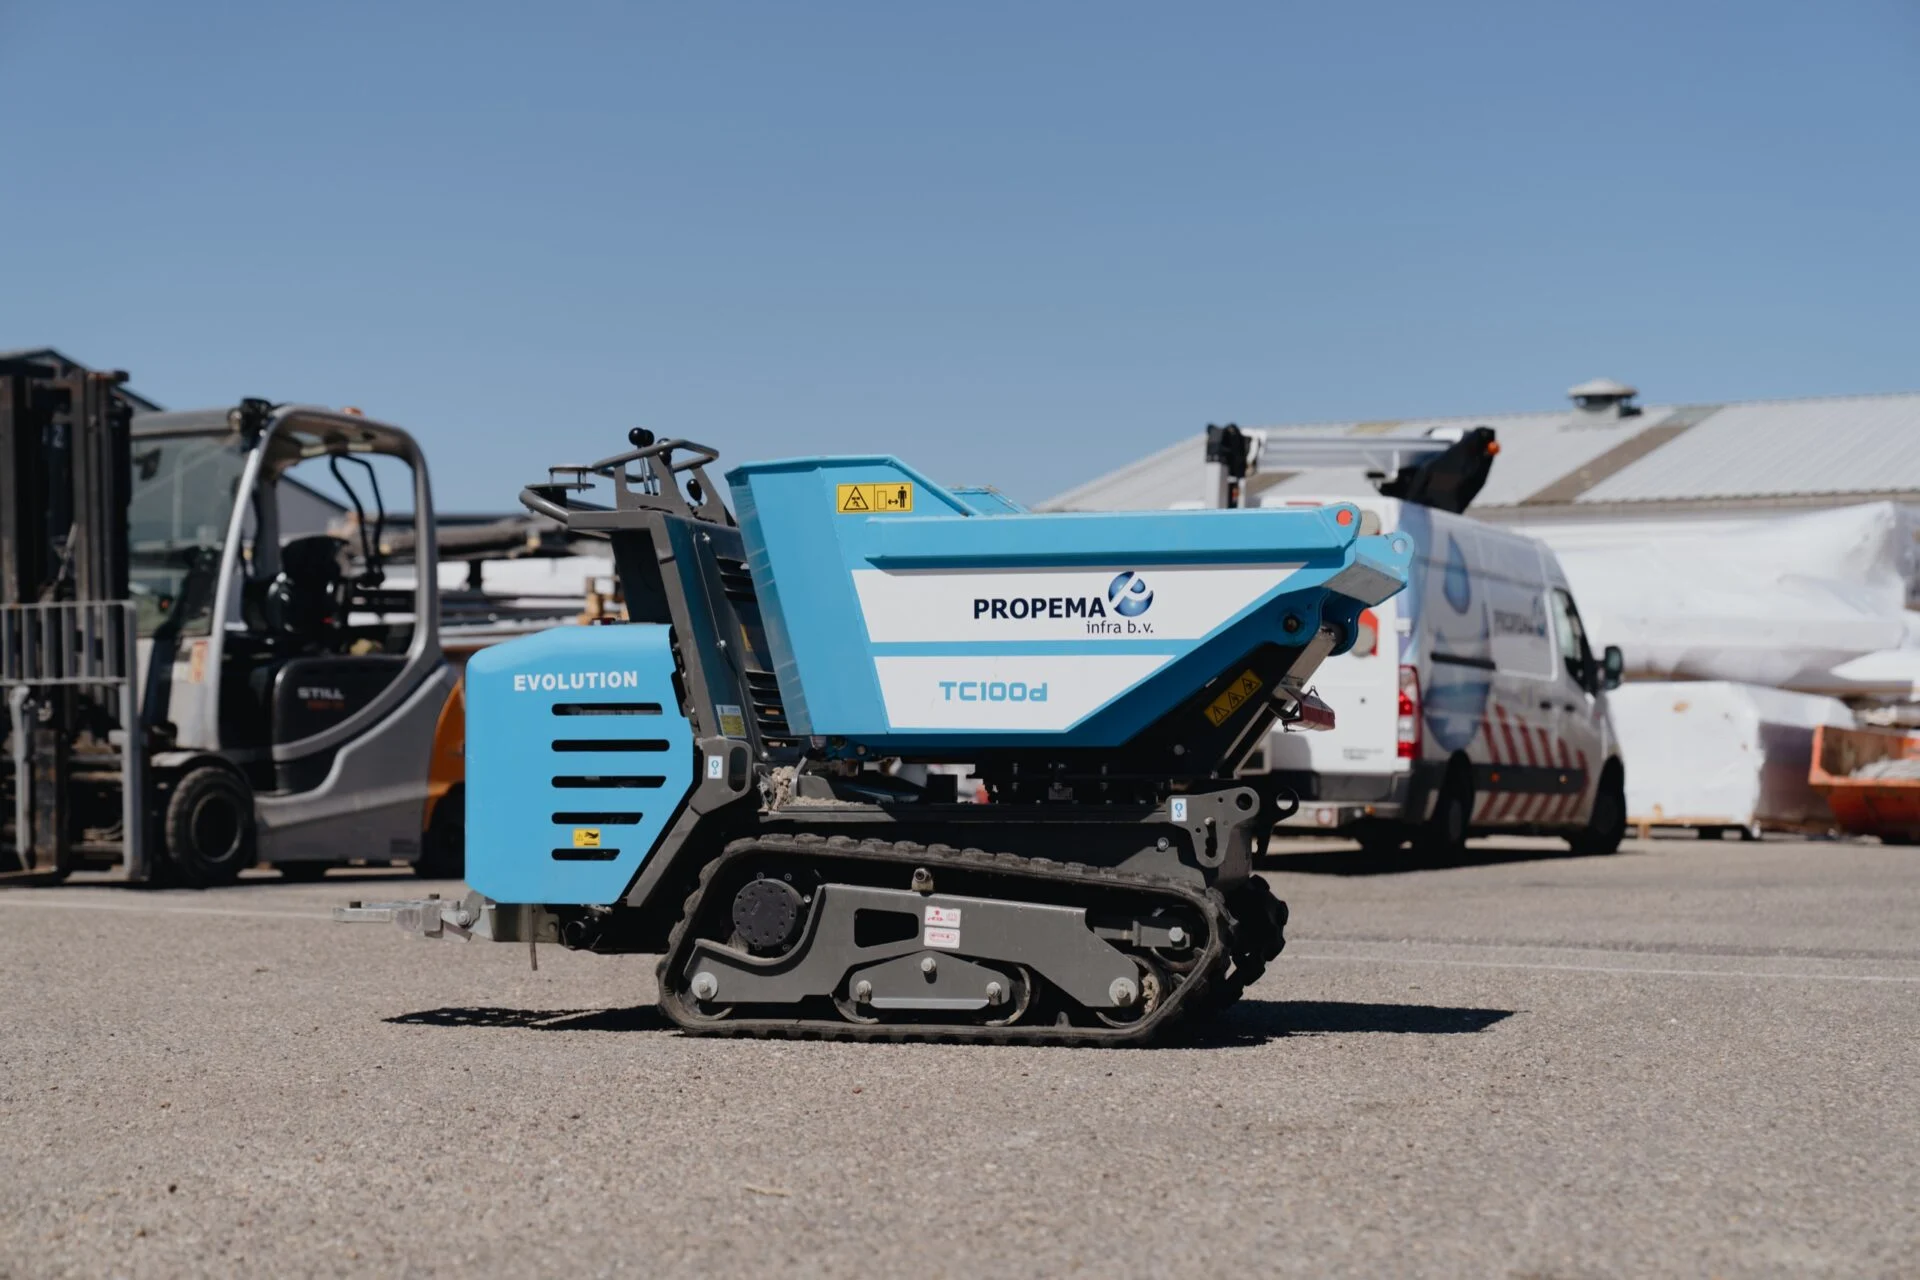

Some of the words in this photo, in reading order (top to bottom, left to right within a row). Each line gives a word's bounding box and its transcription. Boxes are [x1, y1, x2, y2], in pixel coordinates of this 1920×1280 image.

[973, 597, 1106, 619] PROPEMA
[1087, 620, 1122, 634] infra
[1127, 620, 1154, 634] b.v.
[514, 671, 638, 691] EVOLUTION
[939, 682, 1047, 702] TC100d
